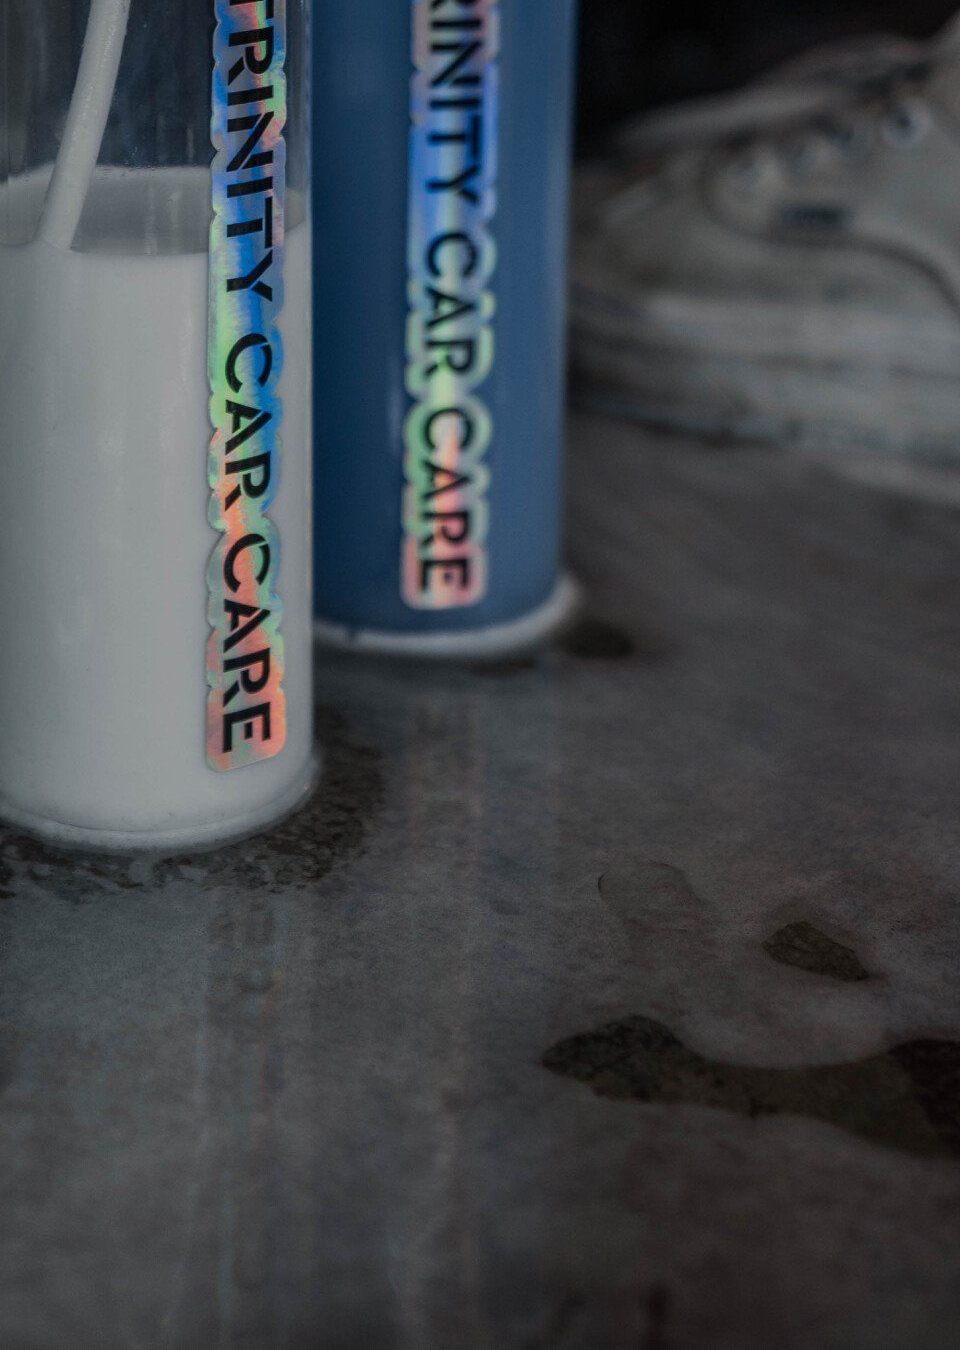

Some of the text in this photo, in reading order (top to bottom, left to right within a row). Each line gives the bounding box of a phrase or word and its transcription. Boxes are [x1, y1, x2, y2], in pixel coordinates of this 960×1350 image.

[426, 232, 477, 379] CAR
[224, 332, 274, 512] CAR
[419, 407, 471, 590] CARE
[222, 532, 272, 754] CARE
